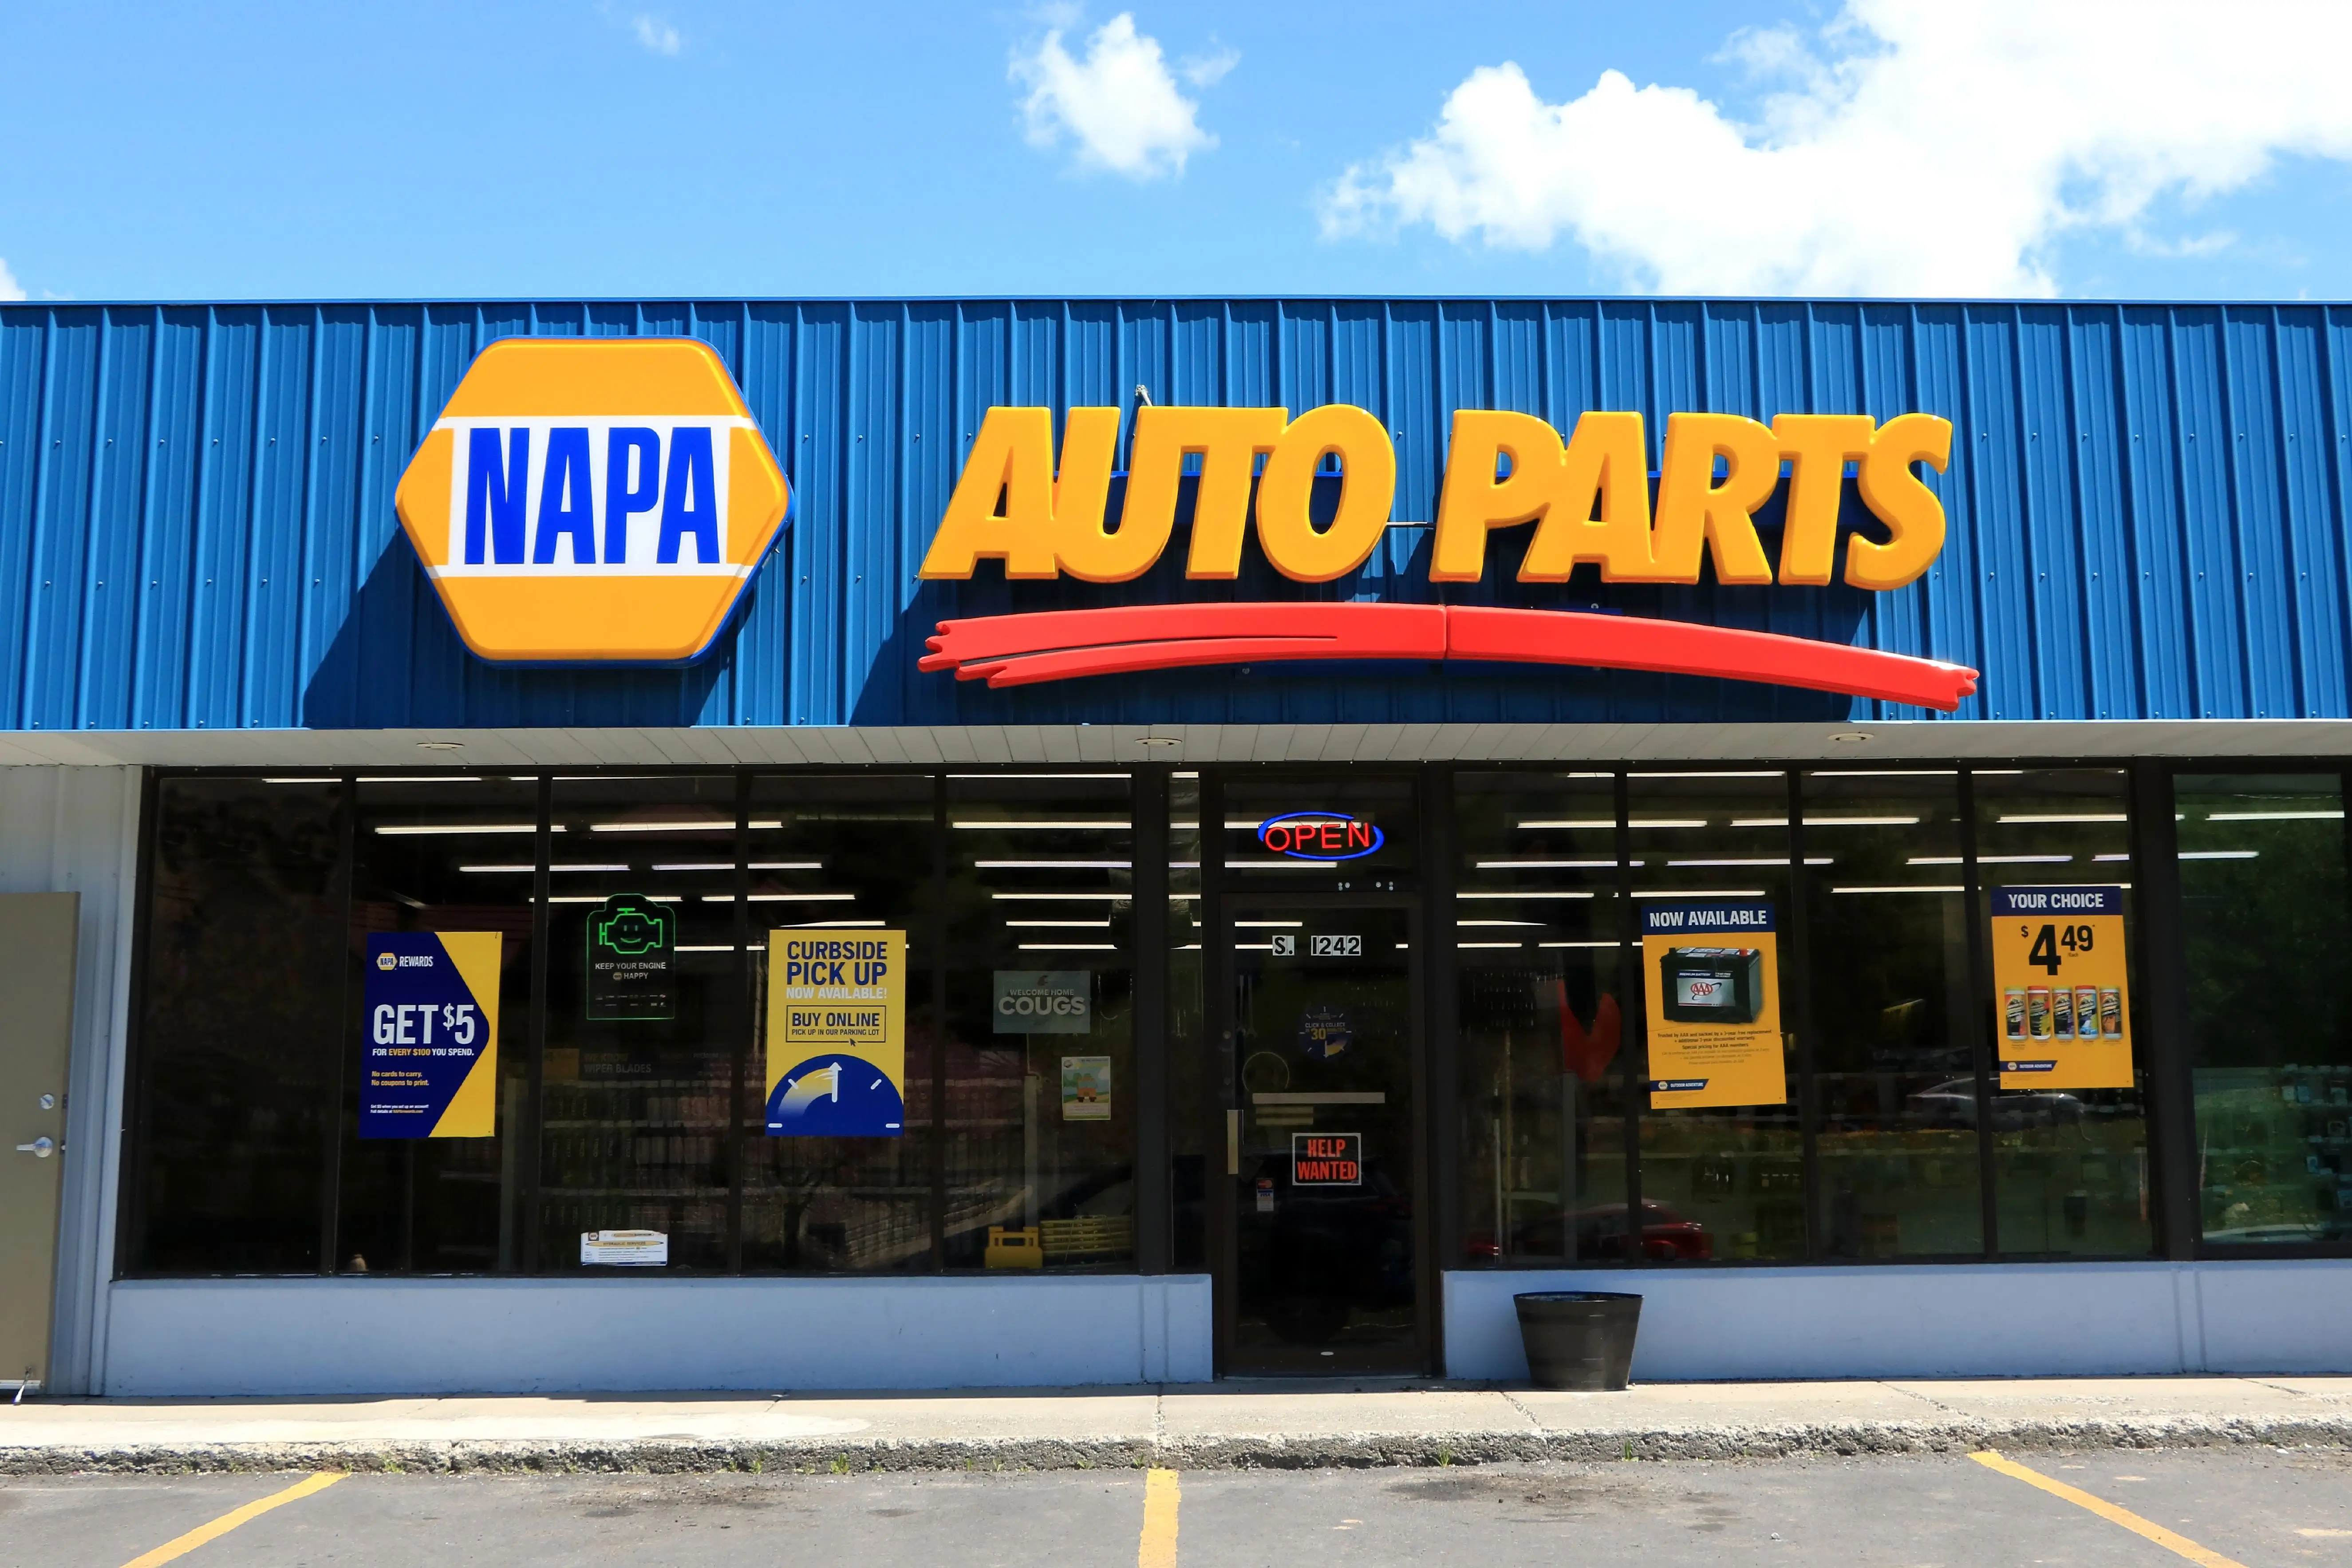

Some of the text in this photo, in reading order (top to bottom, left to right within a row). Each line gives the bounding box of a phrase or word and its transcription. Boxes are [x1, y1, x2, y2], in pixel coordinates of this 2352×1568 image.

[465, 427, 720, 564] NAPA
[919, 404, 1953, 591] AUTO PARTS
[1266, 822, 1369, 851] OPEN
[2008, 893, 2104, 908] YOUR CHOICE
[1650, 910, 1767, 927] NOW AVAILABLE
[787, 941, 888, 960] CURBSIDE
[1274, 936, 1360, 955] S. 1242
[399, 956, 434, 967] REWARDS
[786, 961, 887, 986] PICK UP
[786, 987, 887, 999] NOW AVAILABLE!
[1692, 983, 1712, 995] AAA
[998, 996, 1086, 1015] COUGS
[373, 1003, 475, 1045] GET $5
[792, 1012, 880, 1027] BUY ONLINE
[1310, 1027, 1326, 1040] 30
[584, 1063, 652, 1073] WIPER BLADES
[1307, 1139, 1346, 1157] HELP
[1297, 1161, 1357, 1180] WANTED
